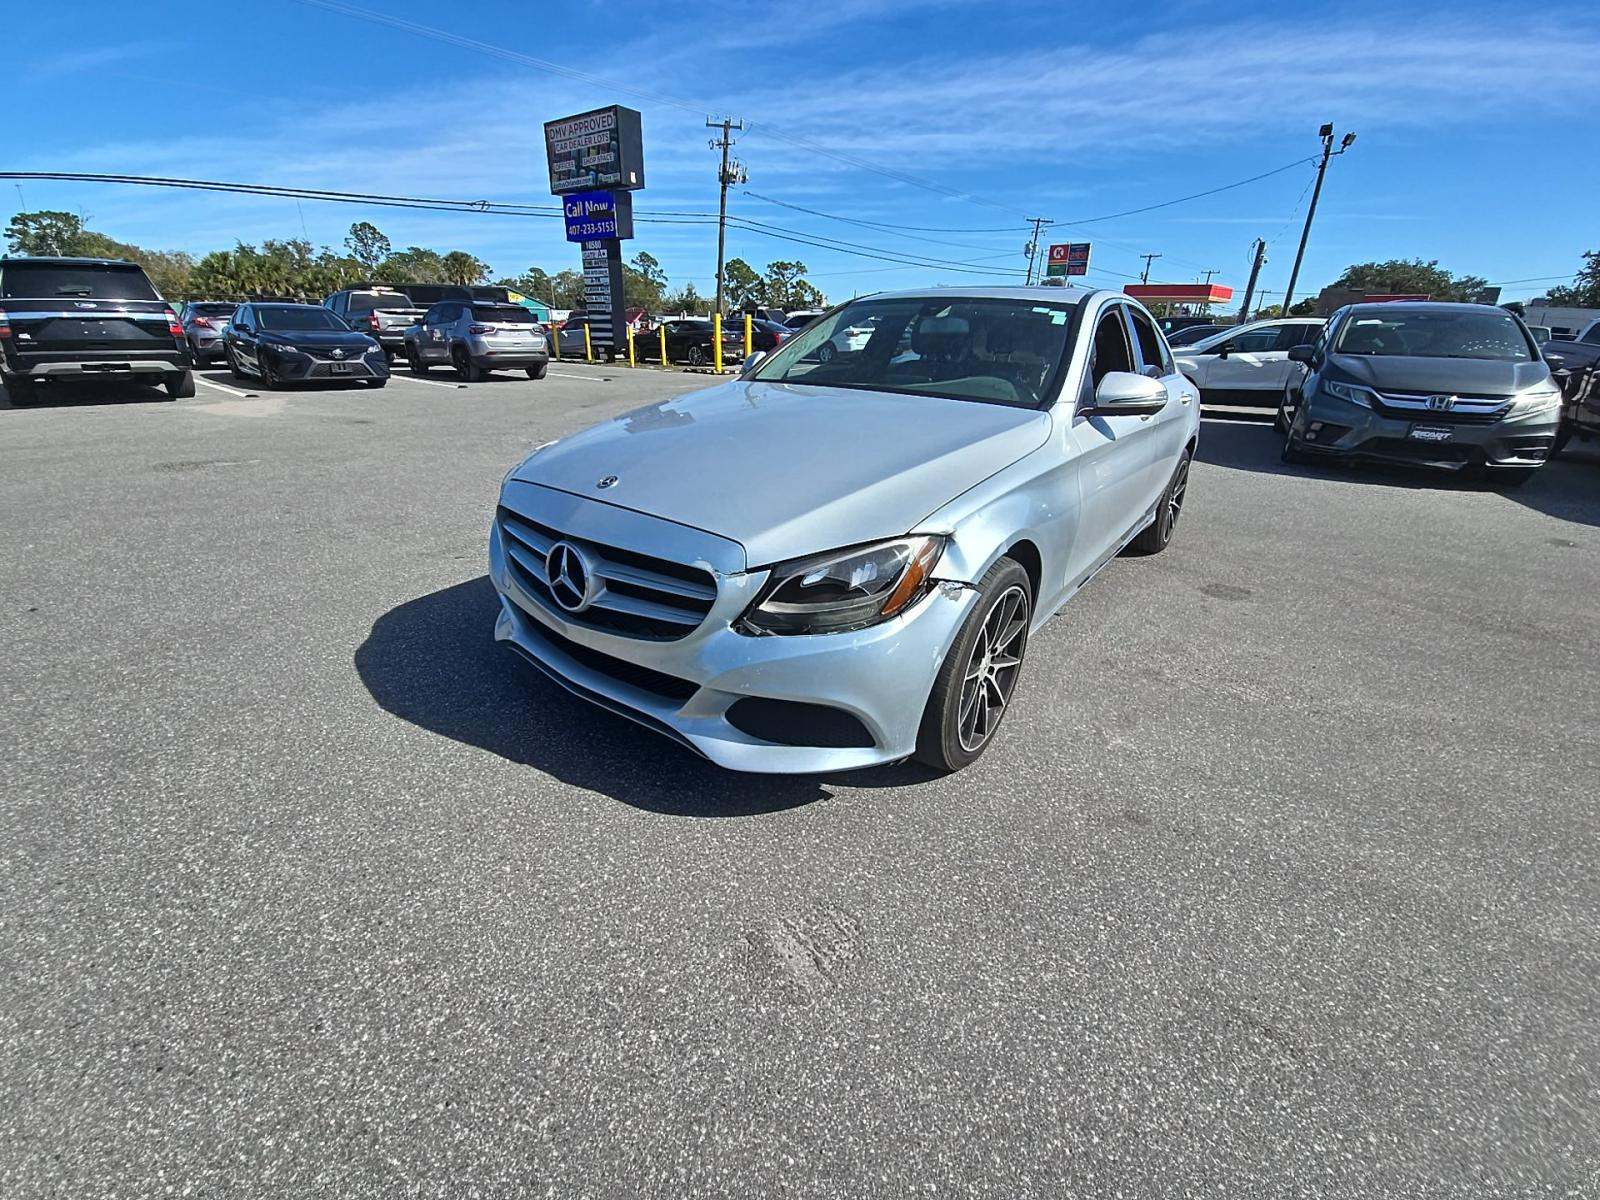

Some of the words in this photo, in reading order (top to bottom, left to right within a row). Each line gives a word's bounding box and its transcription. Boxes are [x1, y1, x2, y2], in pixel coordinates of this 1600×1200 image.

[549, 125, 567, 140] DMV
[568, 114, 613, 136] APPROVED
[556, 142, 568, 152] CAR
[568, 136, 593, 149] DEALER
[593, 132, 609, 144] LOTS
[566, 201, 584, 218] Call
[585, 200, 608, 216] Now
[568, 220, 614, 236] 407-233-5153
